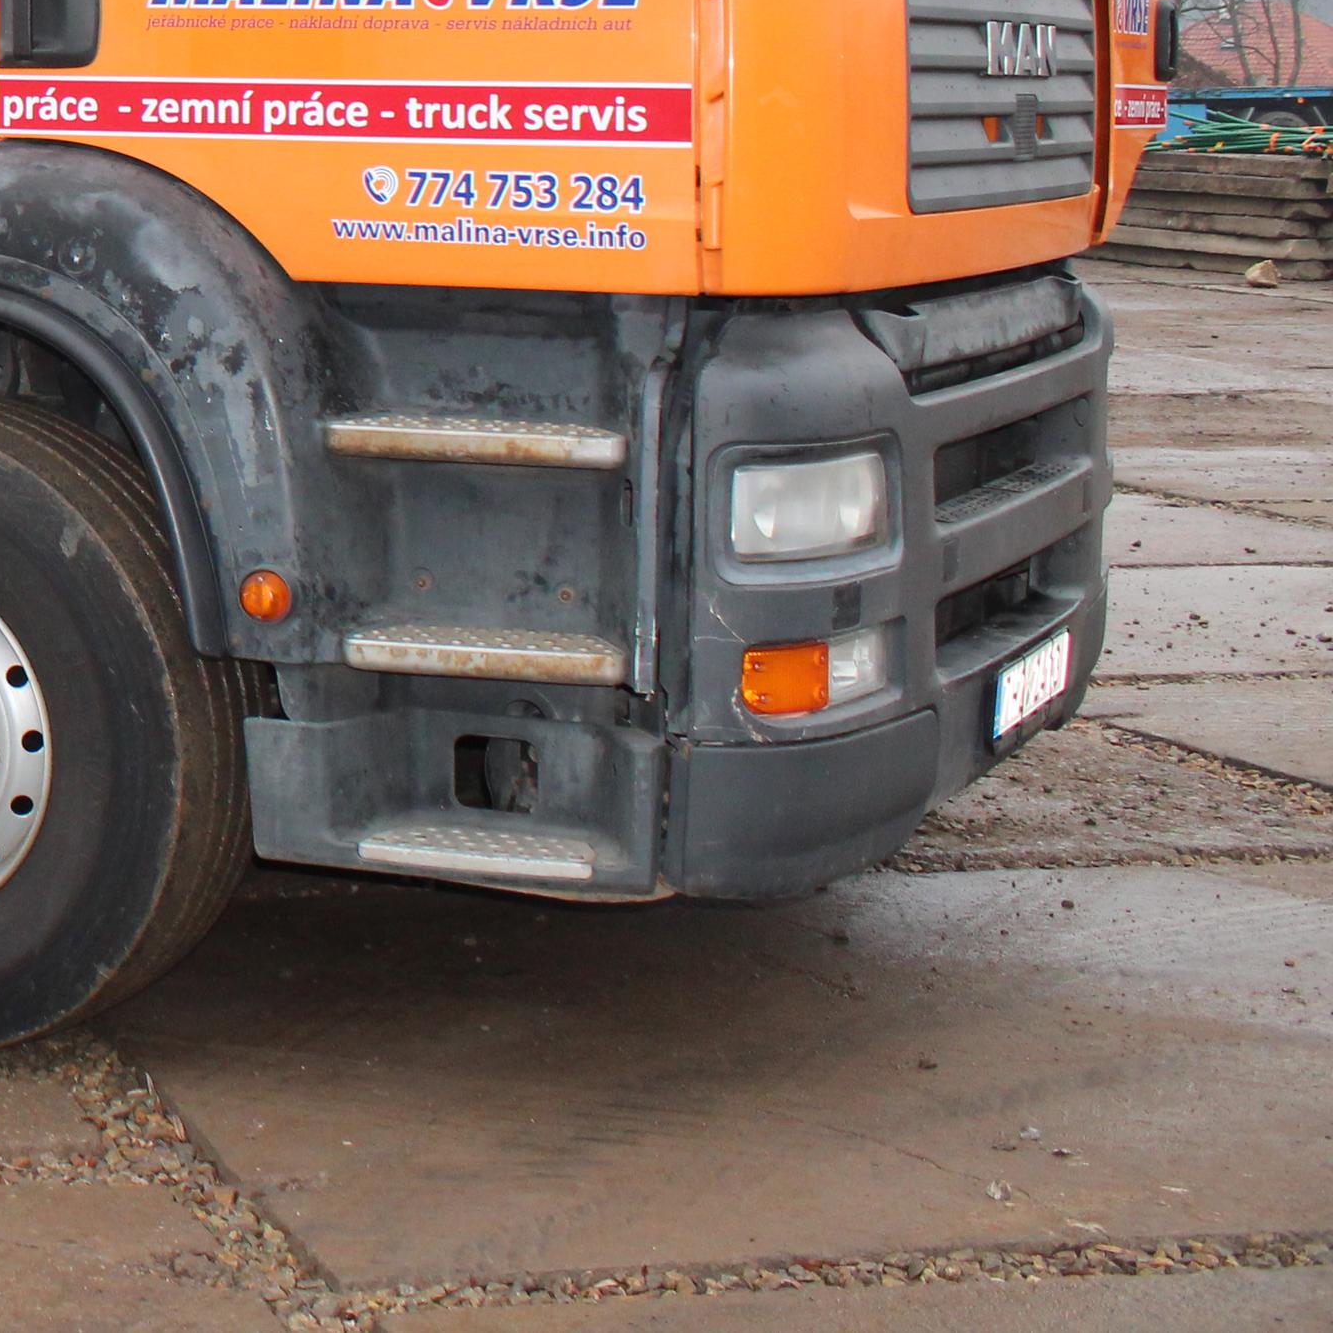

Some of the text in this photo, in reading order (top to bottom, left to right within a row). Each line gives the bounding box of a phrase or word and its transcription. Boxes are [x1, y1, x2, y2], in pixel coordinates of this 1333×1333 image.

[146, 15, 226, 31] jeřábnické
[231, 16, 274, 33] práce
[289, 15, 359, 30] nákladní
[363, 16, 430, 33] doprava
[446, 17, 497, 31] servis
[501, 16, 598, 32] nákladních
[603, 19, 632, 32] aut
[986, 21, 1056, 76] MAN
[3, 87, 98, 126] práce
[141, 90, 254, 125] zemní
[263, 91, 369, 133] práce
[405, 94, 513, 130] truck
[523, 96, 648, 132] servis
[406, 171, 644, 212] 774 753 284
[332, 218, 647, 250] www.malina-vrse.info
